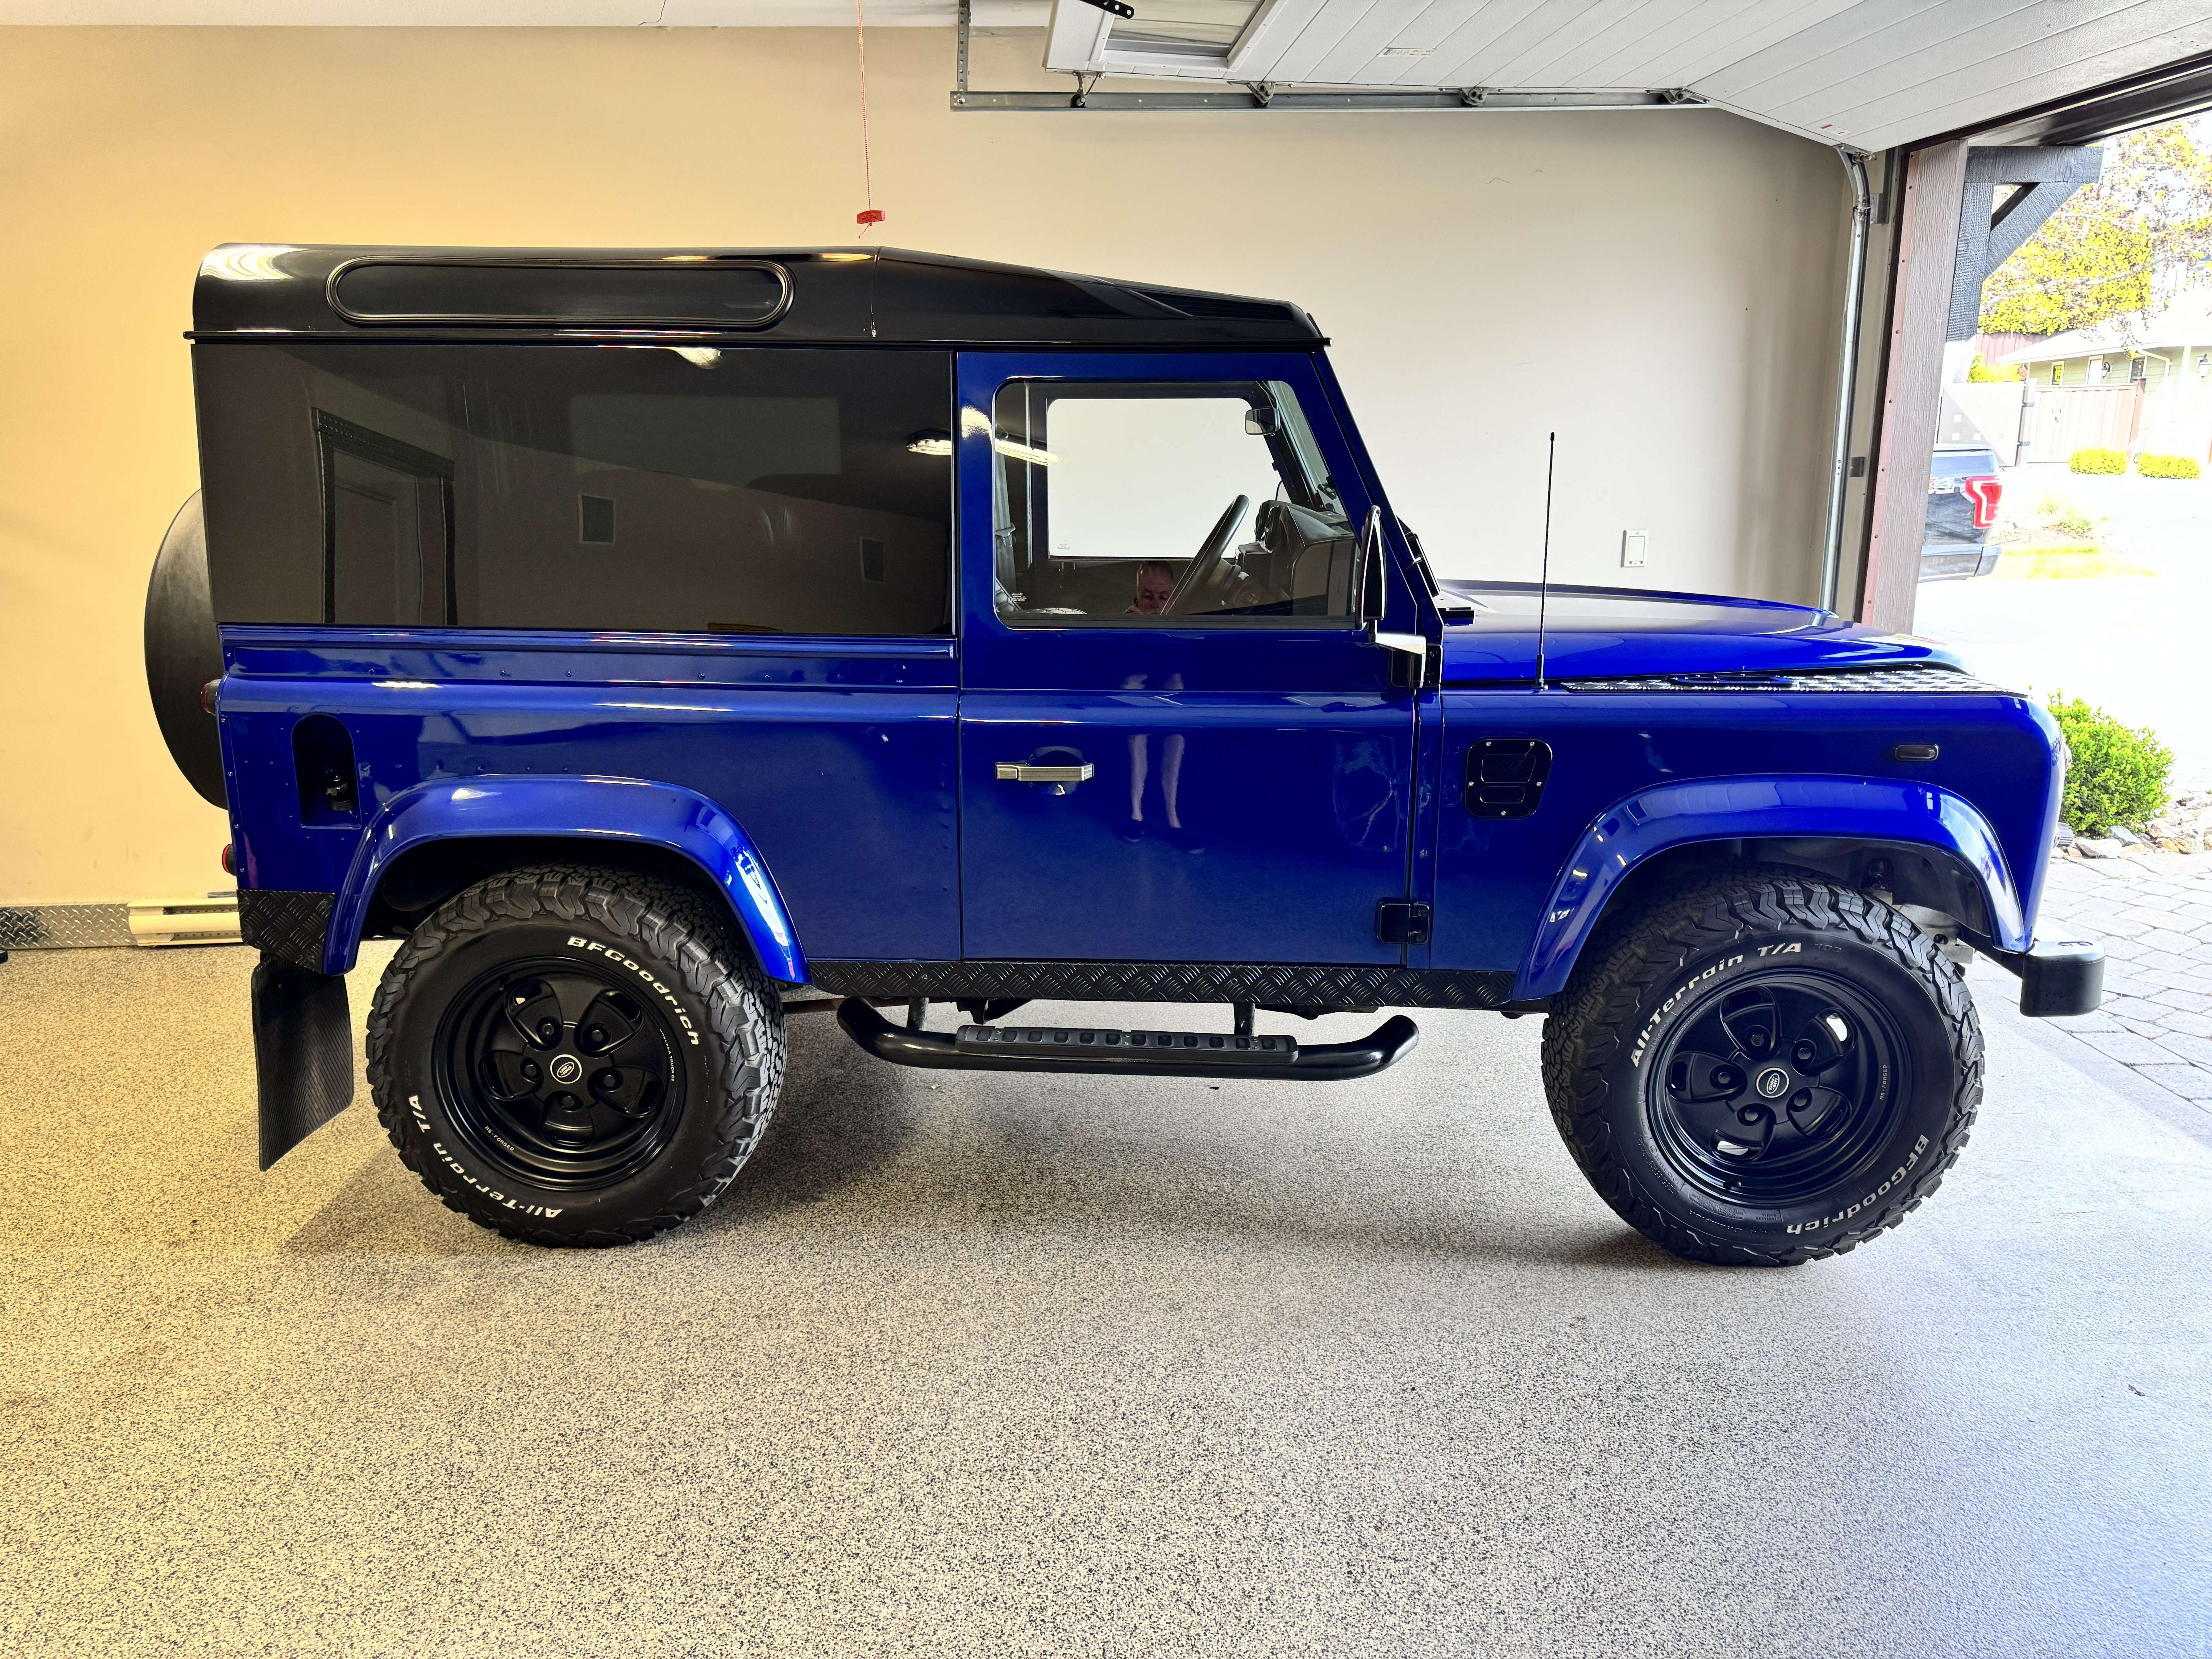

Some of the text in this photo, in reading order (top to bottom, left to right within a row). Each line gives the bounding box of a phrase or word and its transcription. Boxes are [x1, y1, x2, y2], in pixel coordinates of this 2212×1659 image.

[567, 936, 699, 1045] BFGoodrich
[1631, 954, 1743, 1068] All-Terrain
[1757, 942, 1802, 957] T/A
[409, 1095, 563, 1218] All-Terrain T/A
[1787, 1134, 1930, 1235] BFGoodrich
